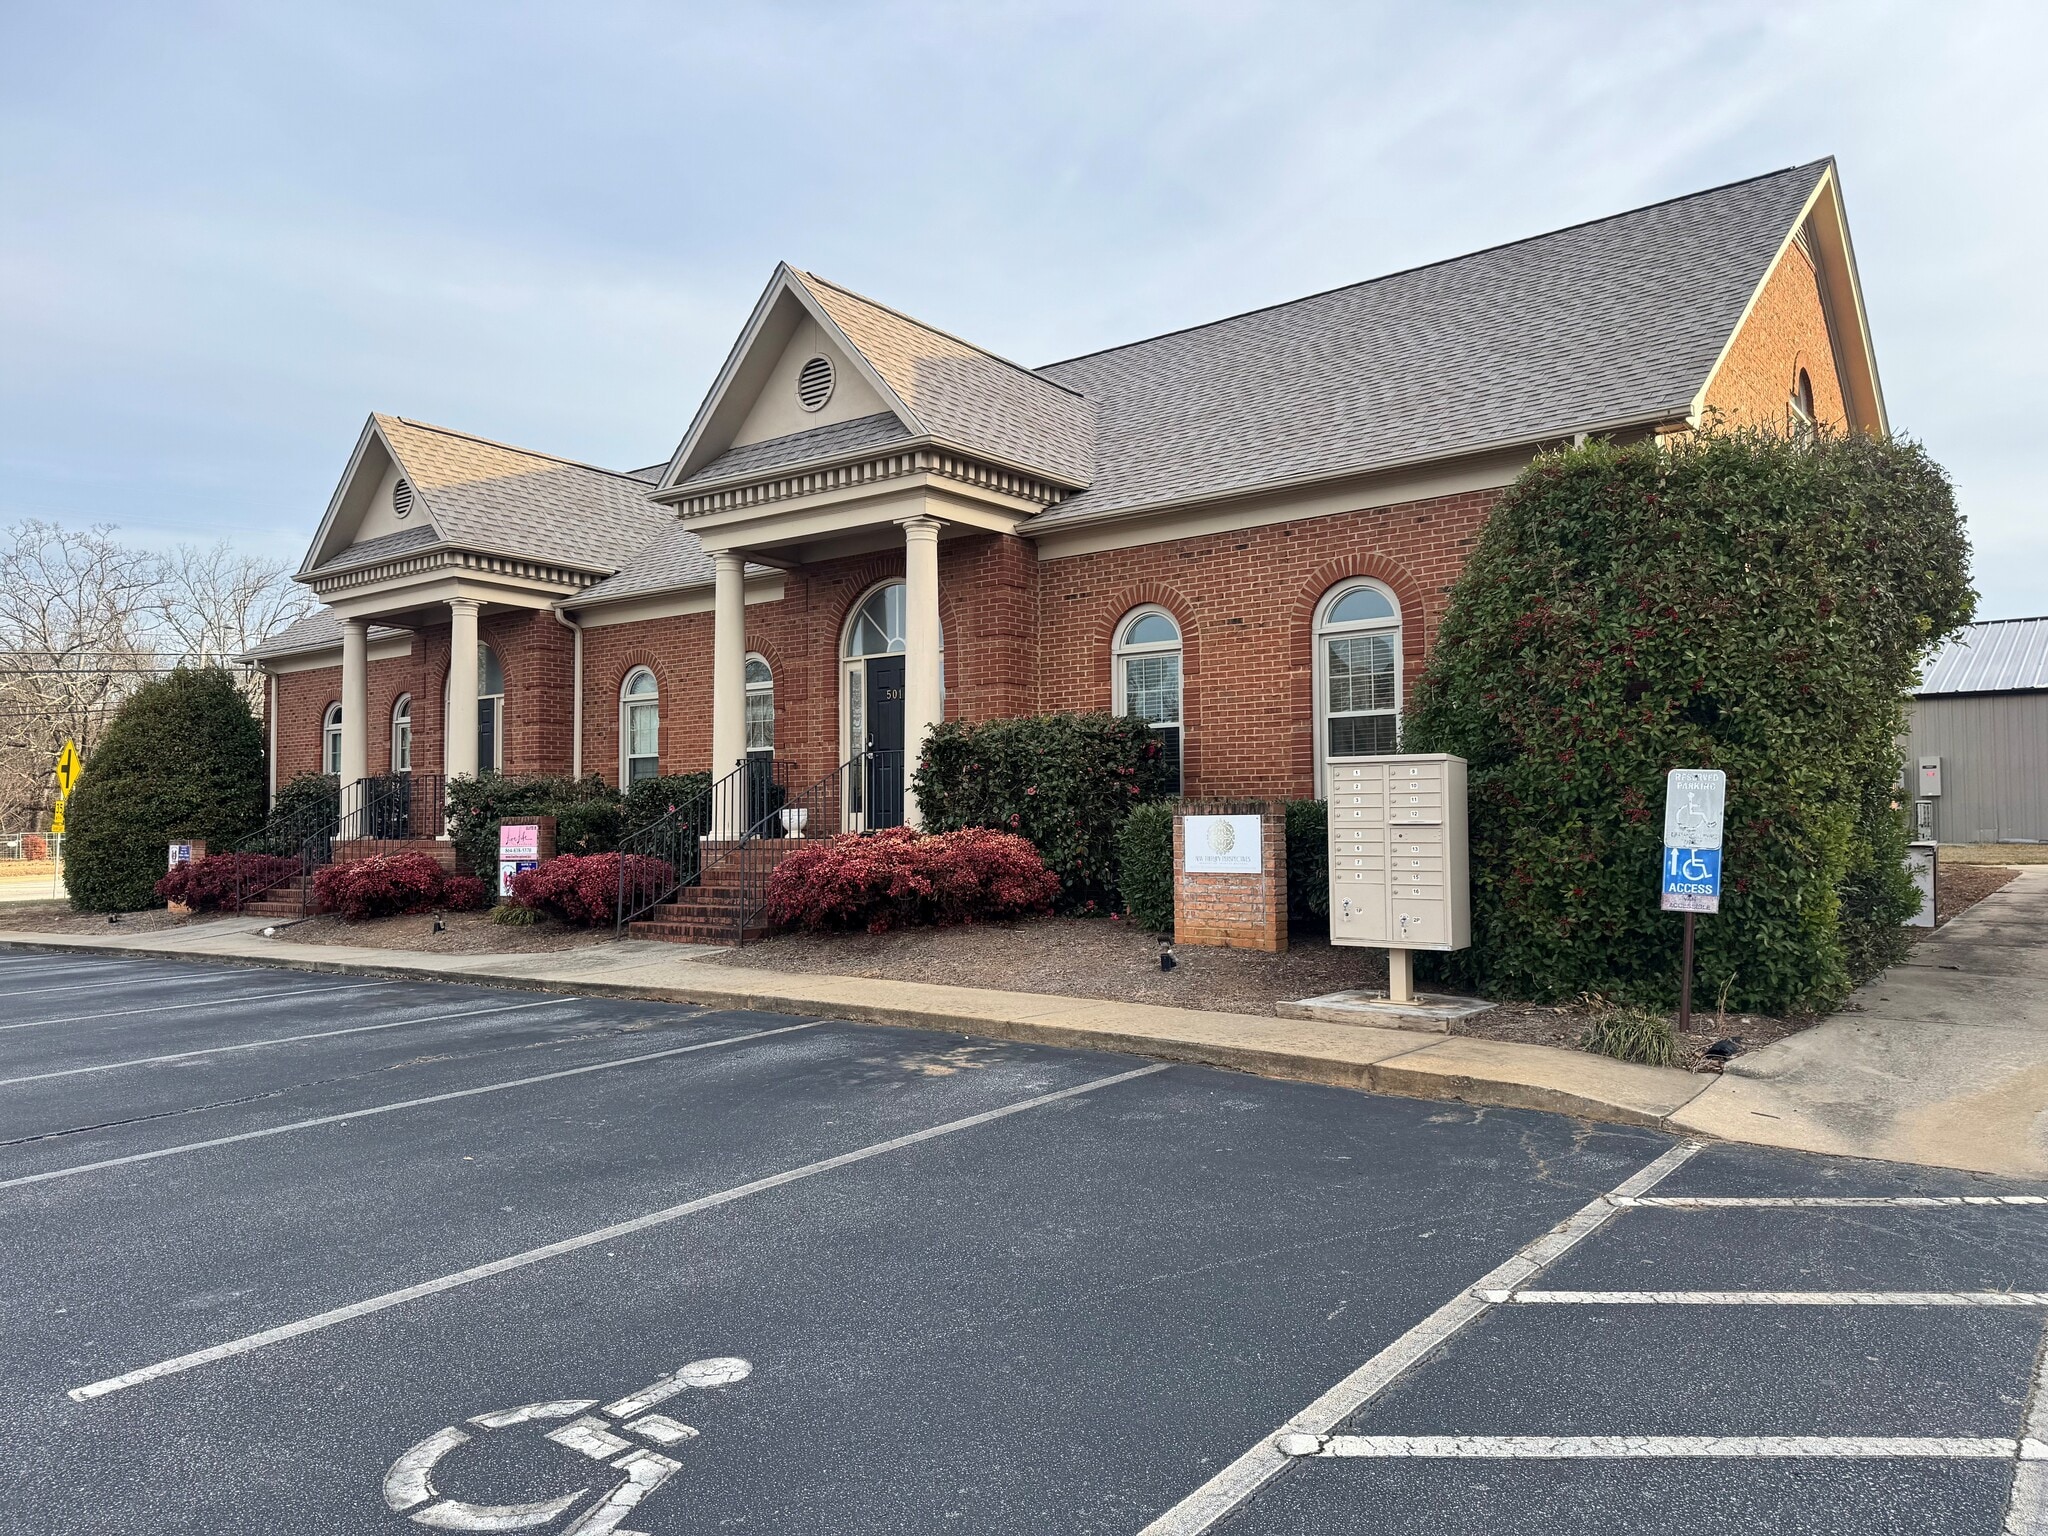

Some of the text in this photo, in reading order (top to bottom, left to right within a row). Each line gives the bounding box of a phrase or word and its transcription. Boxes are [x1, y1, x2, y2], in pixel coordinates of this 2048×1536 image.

[886, 689, 902, 700] 501
[1675, 773, 1719, 781] RESERVED
[1677, 782, 1716, 790] PARKING
[1669, 883, 1713, 894] ACCESS
